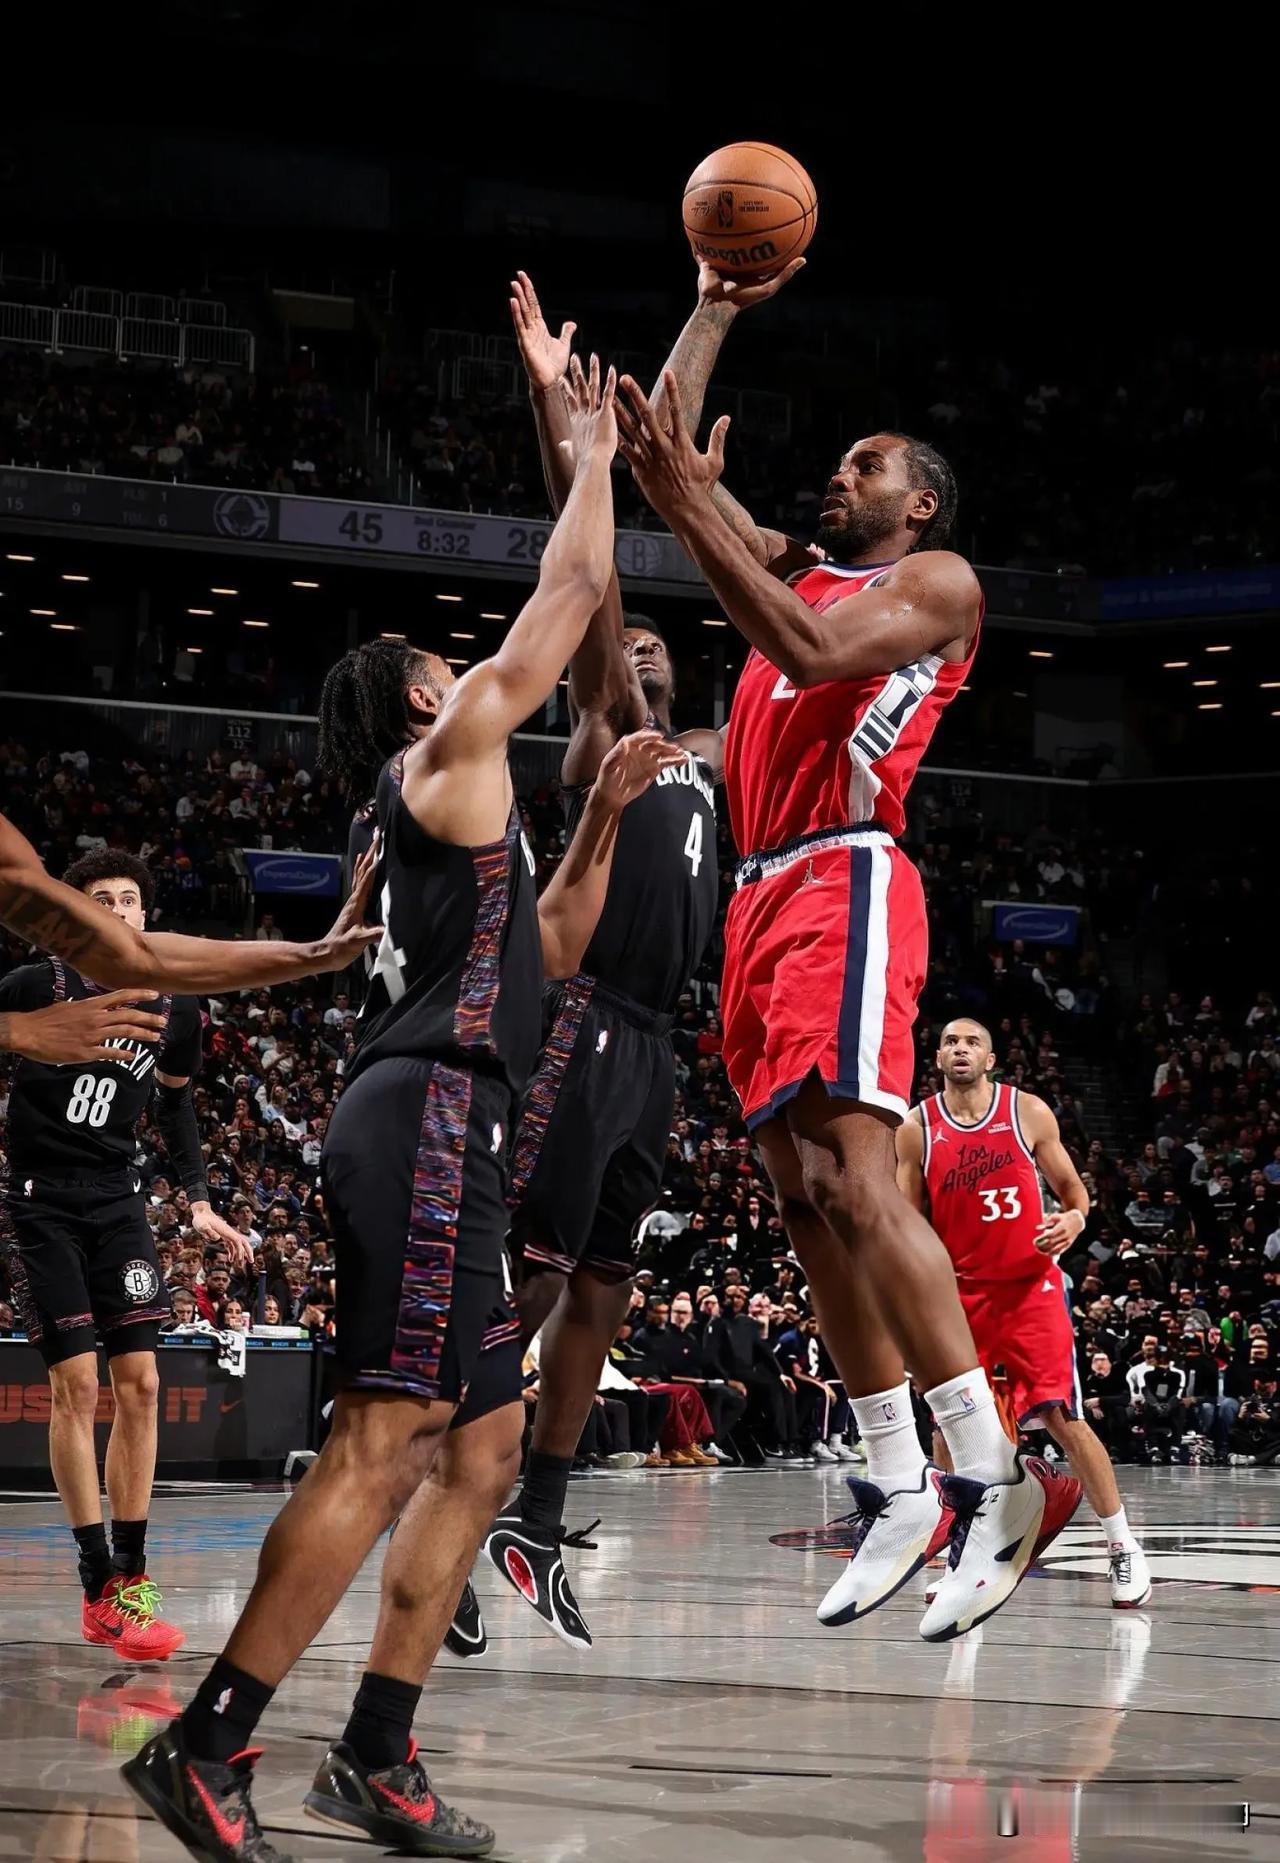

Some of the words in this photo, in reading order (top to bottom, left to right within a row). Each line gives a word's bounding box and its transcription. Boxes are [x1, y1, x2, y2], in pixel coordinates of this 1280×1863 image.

[696, 241, 780, 267] Wilson
[7, 496, 24, 512] 15
[72, 502, 81, 516] 9
[158, 513, 168, 527] 6
[338, 511, 383, 544] 45
[417, 530, 471, 555] 8:32
[507, 528, 546, 560] 28
[684, 811, 703, 878] 4
[66, 1073, 118, 1128] 88
[957, 1143, 990, 1170] Los
[943, 1150, 1016, 1194] Angeles
[977, 1185, 1023, 1222] 33
[133, 1272, 144, 1292] B
[164, 1386, 208, 1423] IT
